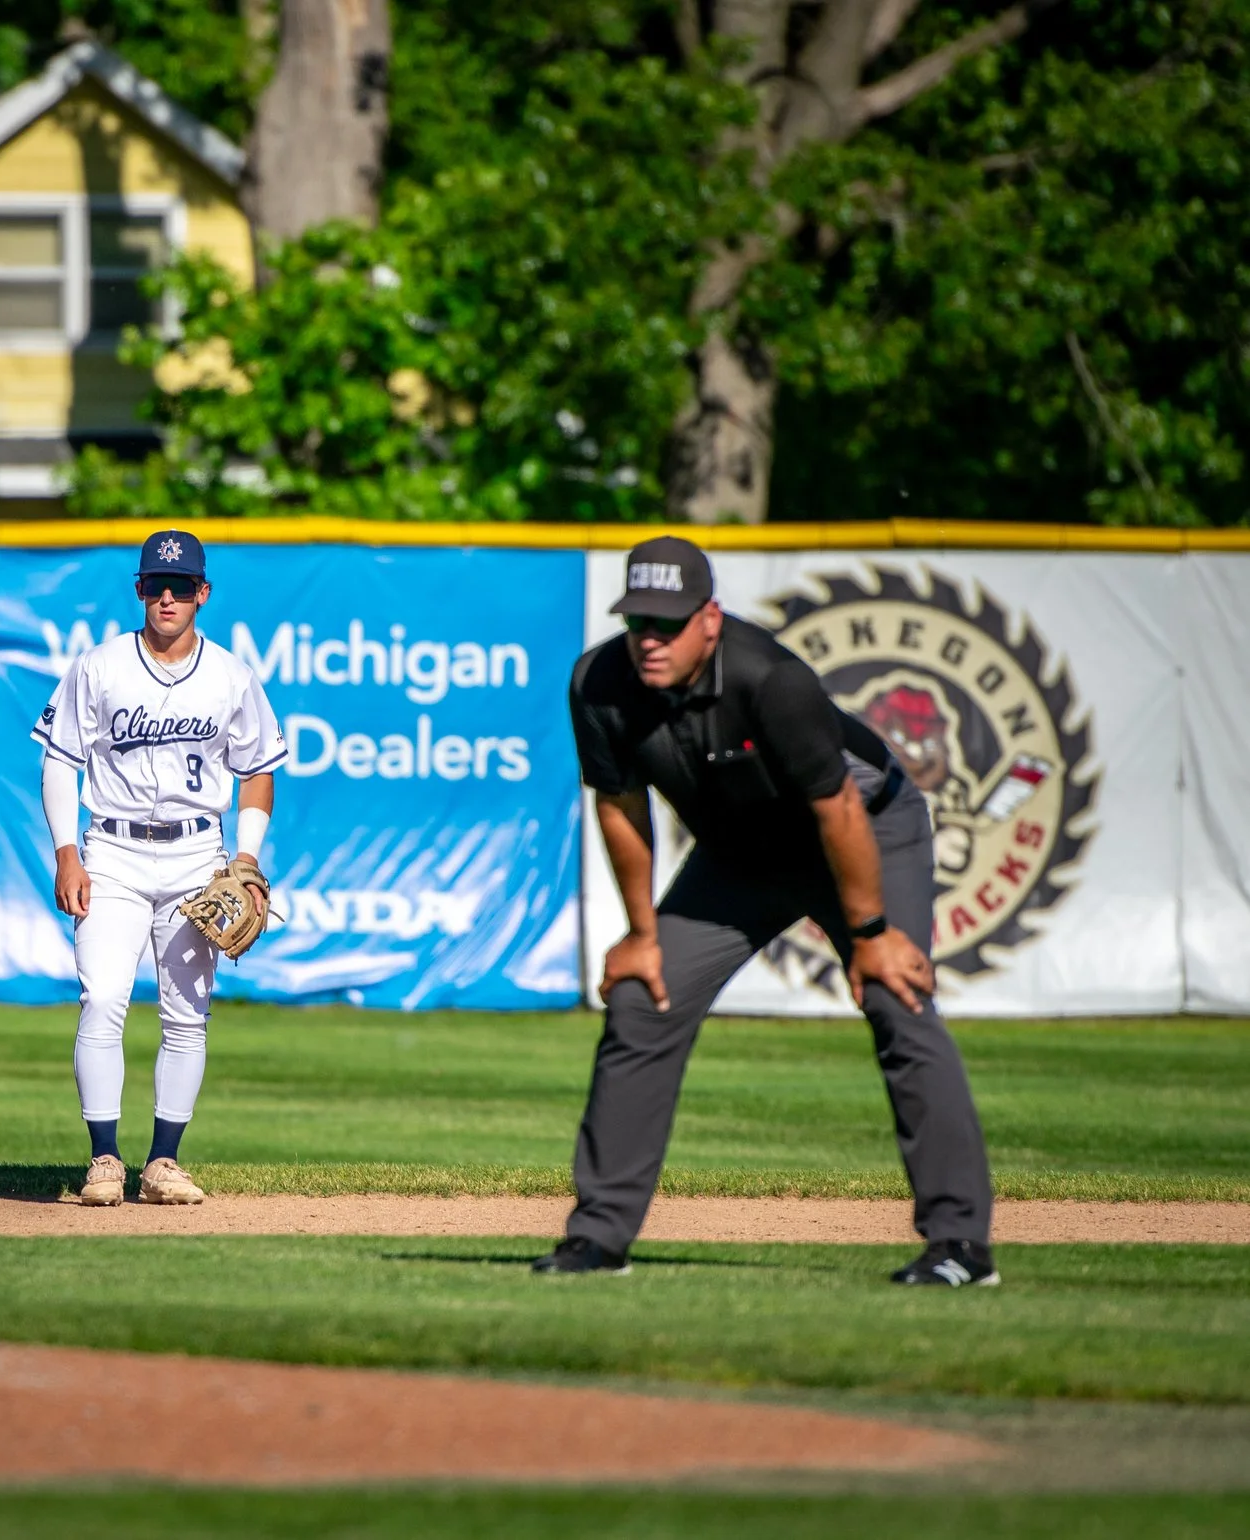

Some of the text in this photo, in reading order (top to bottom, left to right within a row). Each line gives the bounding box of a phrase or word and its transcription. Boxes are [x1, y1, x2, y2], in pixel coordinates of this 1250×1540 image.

[231, 619, 529, 705] Michigan
[801, 616, 1037, 738] SKEGON
[110, 705, 218, 746] Clippers
[284, 715, 531, 782] Dealers
[186, 753, 203, 792] 9
[268, 887, 479, 939] NDA
